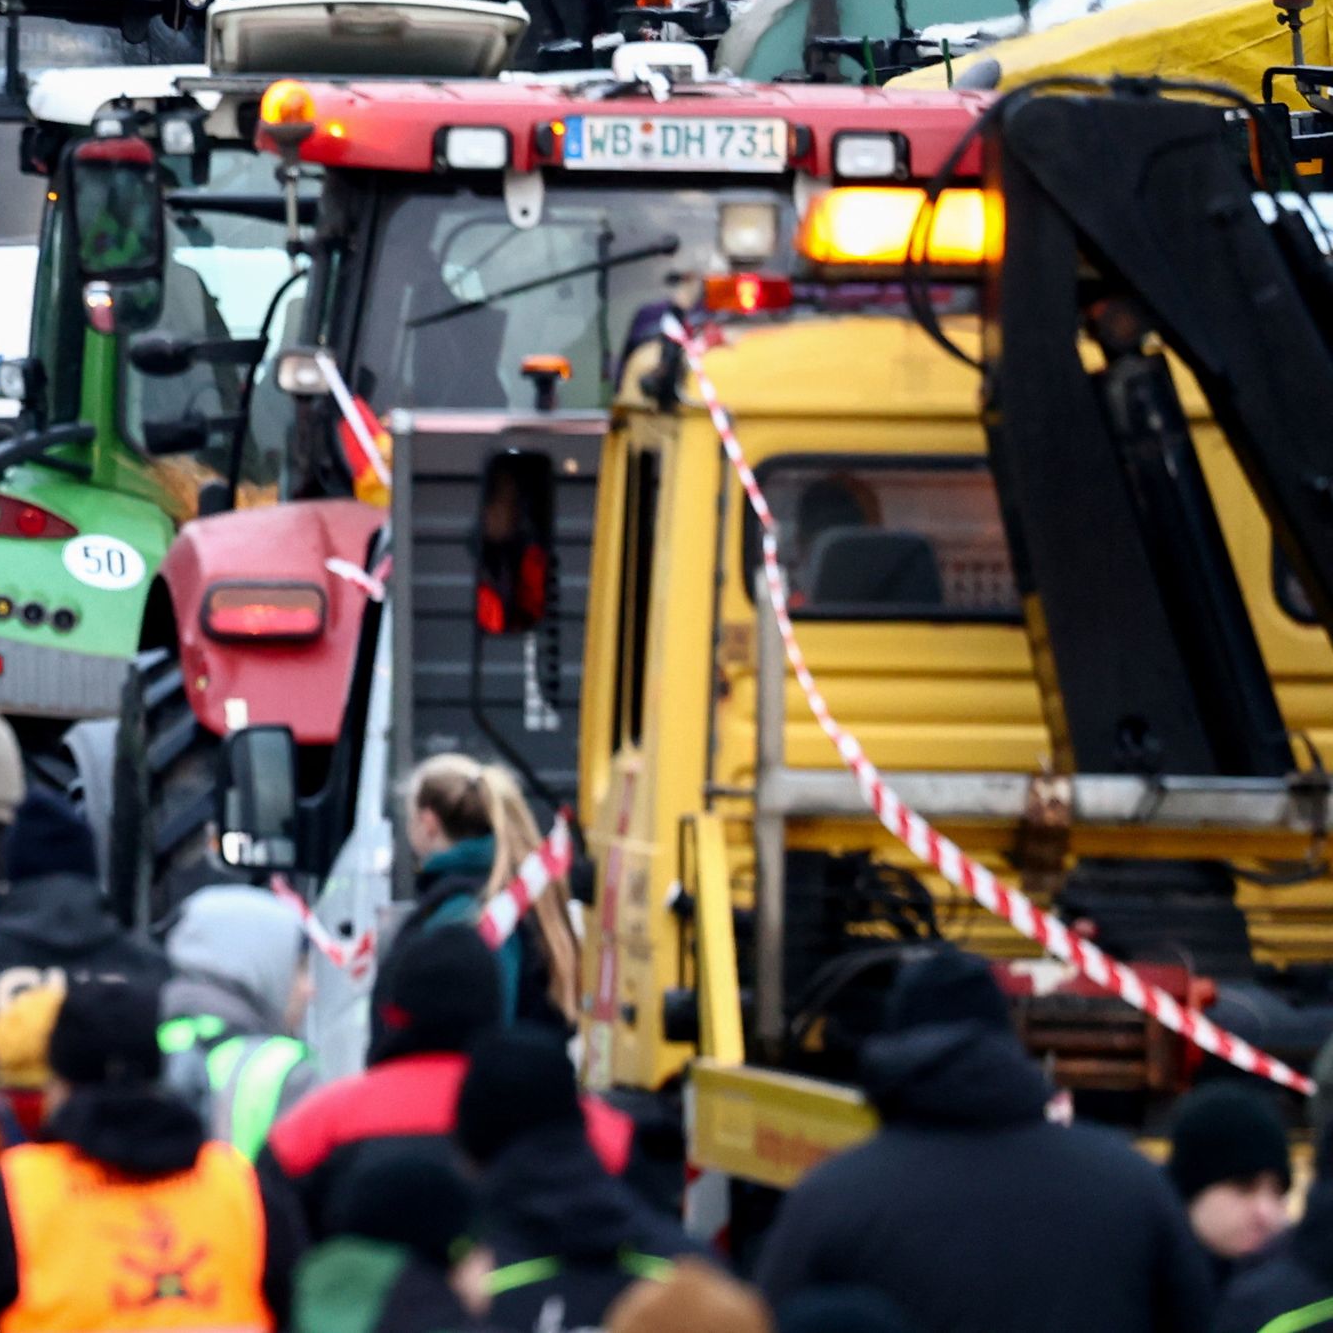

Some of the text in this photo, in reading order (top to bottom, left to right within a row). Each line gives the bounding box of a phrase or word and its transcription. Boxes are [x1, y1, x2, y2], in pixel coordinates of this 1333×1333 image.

[589, 123, 779, 158] WB DH 731
[84, 546, 125, 577] 50
